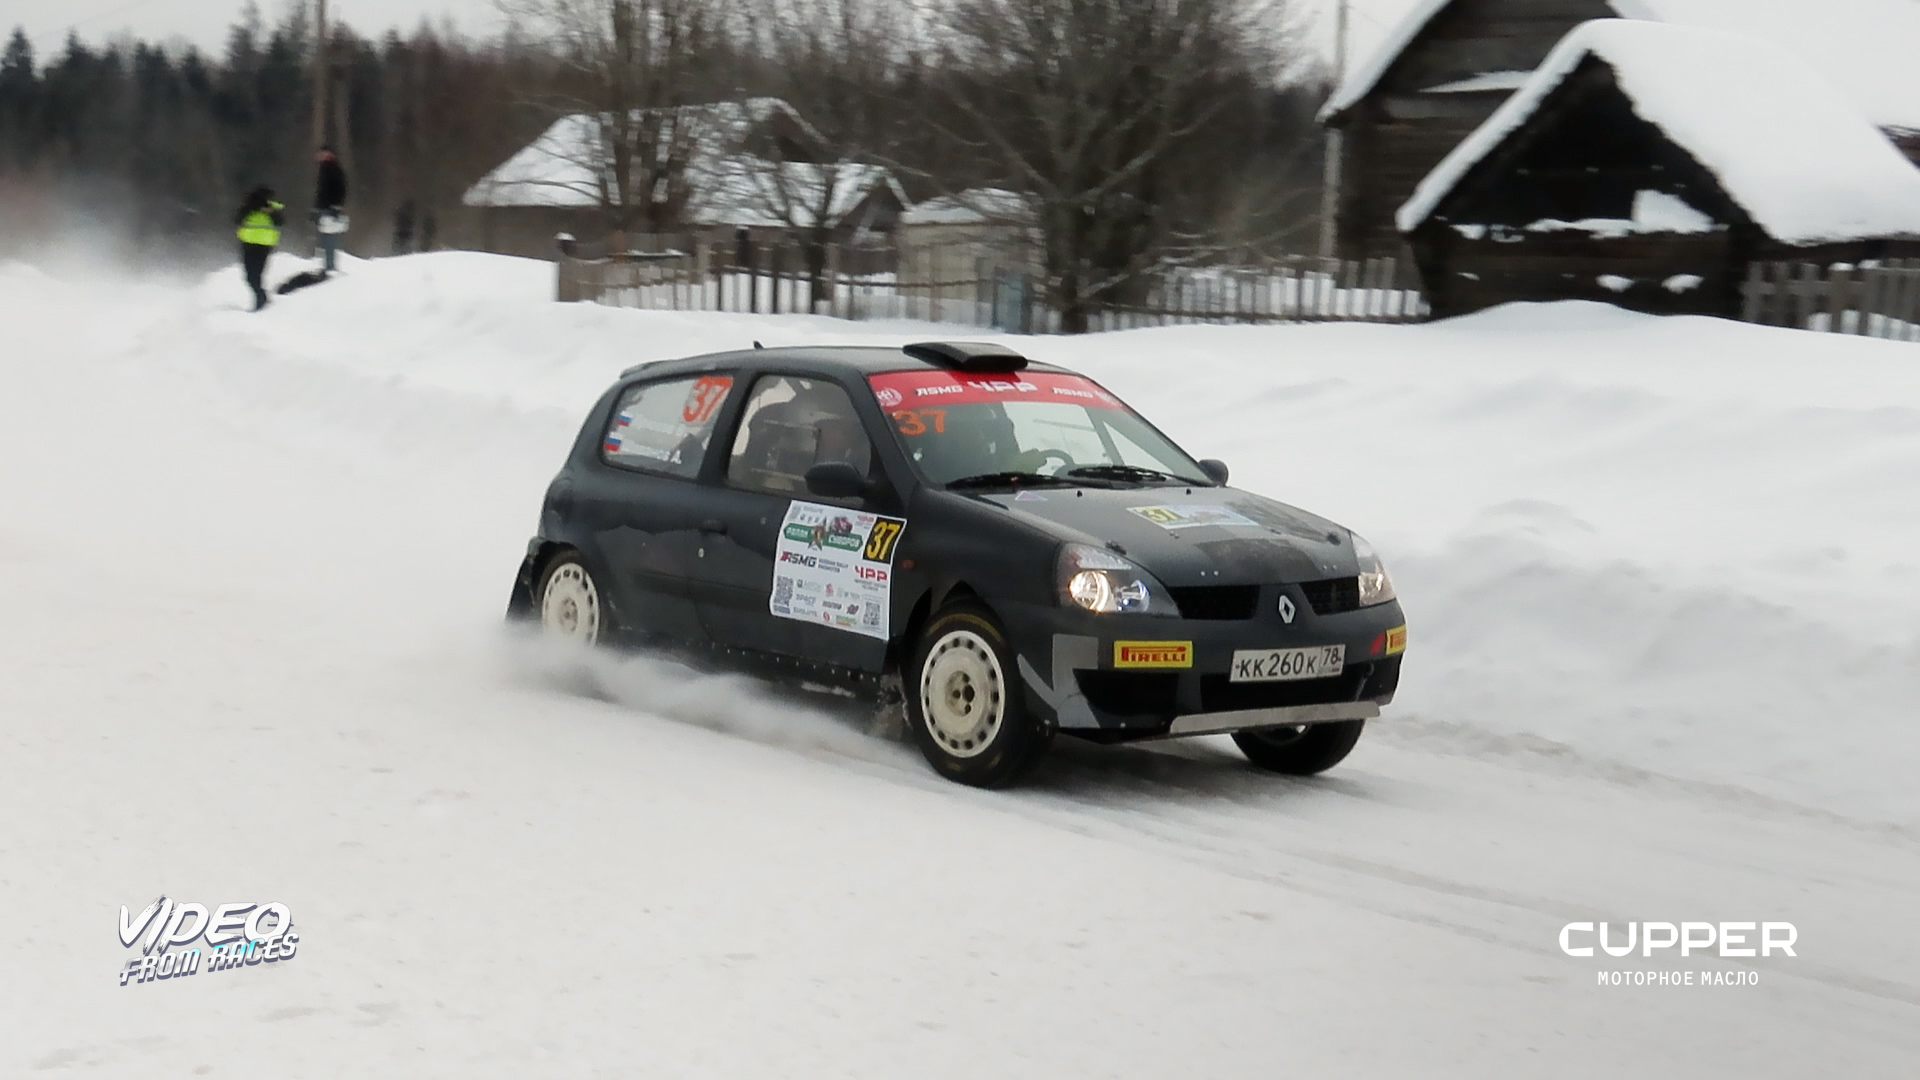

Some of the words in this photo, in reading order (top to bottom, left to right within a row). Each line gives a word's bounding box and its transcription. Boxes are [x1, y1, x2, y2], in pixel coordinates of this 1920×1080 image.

[683, 375, 734, 423] 37
[893, 410, 947, 436] 37
[867, 521, 900, 560] 37
[781, 551, 817, 567] RSMG
[855, 565, 888, 581] ЧРР
[1121, 646, 1186, 662] PIRELLI
[1323, 647, 1340, 665] 78
